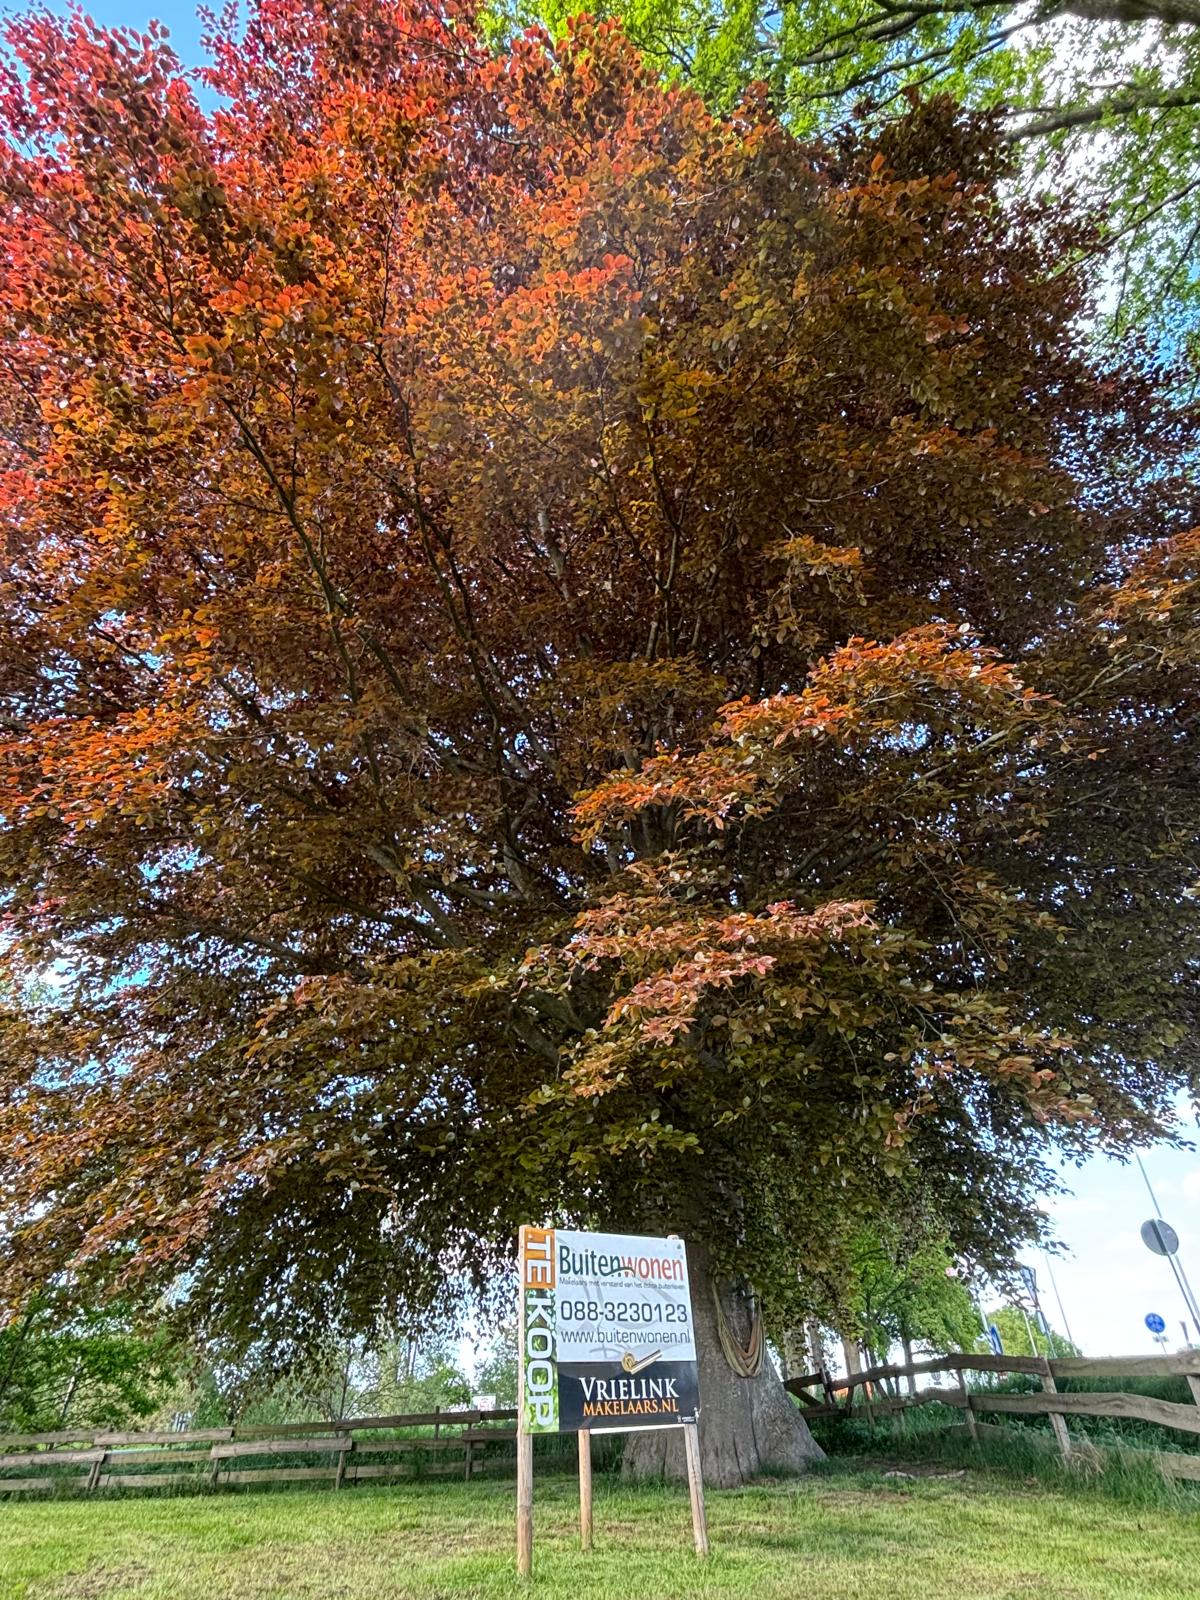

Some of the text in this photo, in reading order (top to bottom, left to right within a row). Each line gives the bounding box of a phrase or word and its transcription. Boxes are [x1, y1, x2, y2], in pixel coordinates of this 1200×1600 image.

[559, 1245, 684, 1281] Buitenwonen
[560, 1300, 688, 1322] 088-3230123
[526, 1235, 554, 1426] TE KOOP
[560, 1328, 691, 1344] www.buitenwonen.nl
[578, 1377, 680, 1401] VRIELINK
[583, 1399, 680, 1417] MAKELAARS.NL
